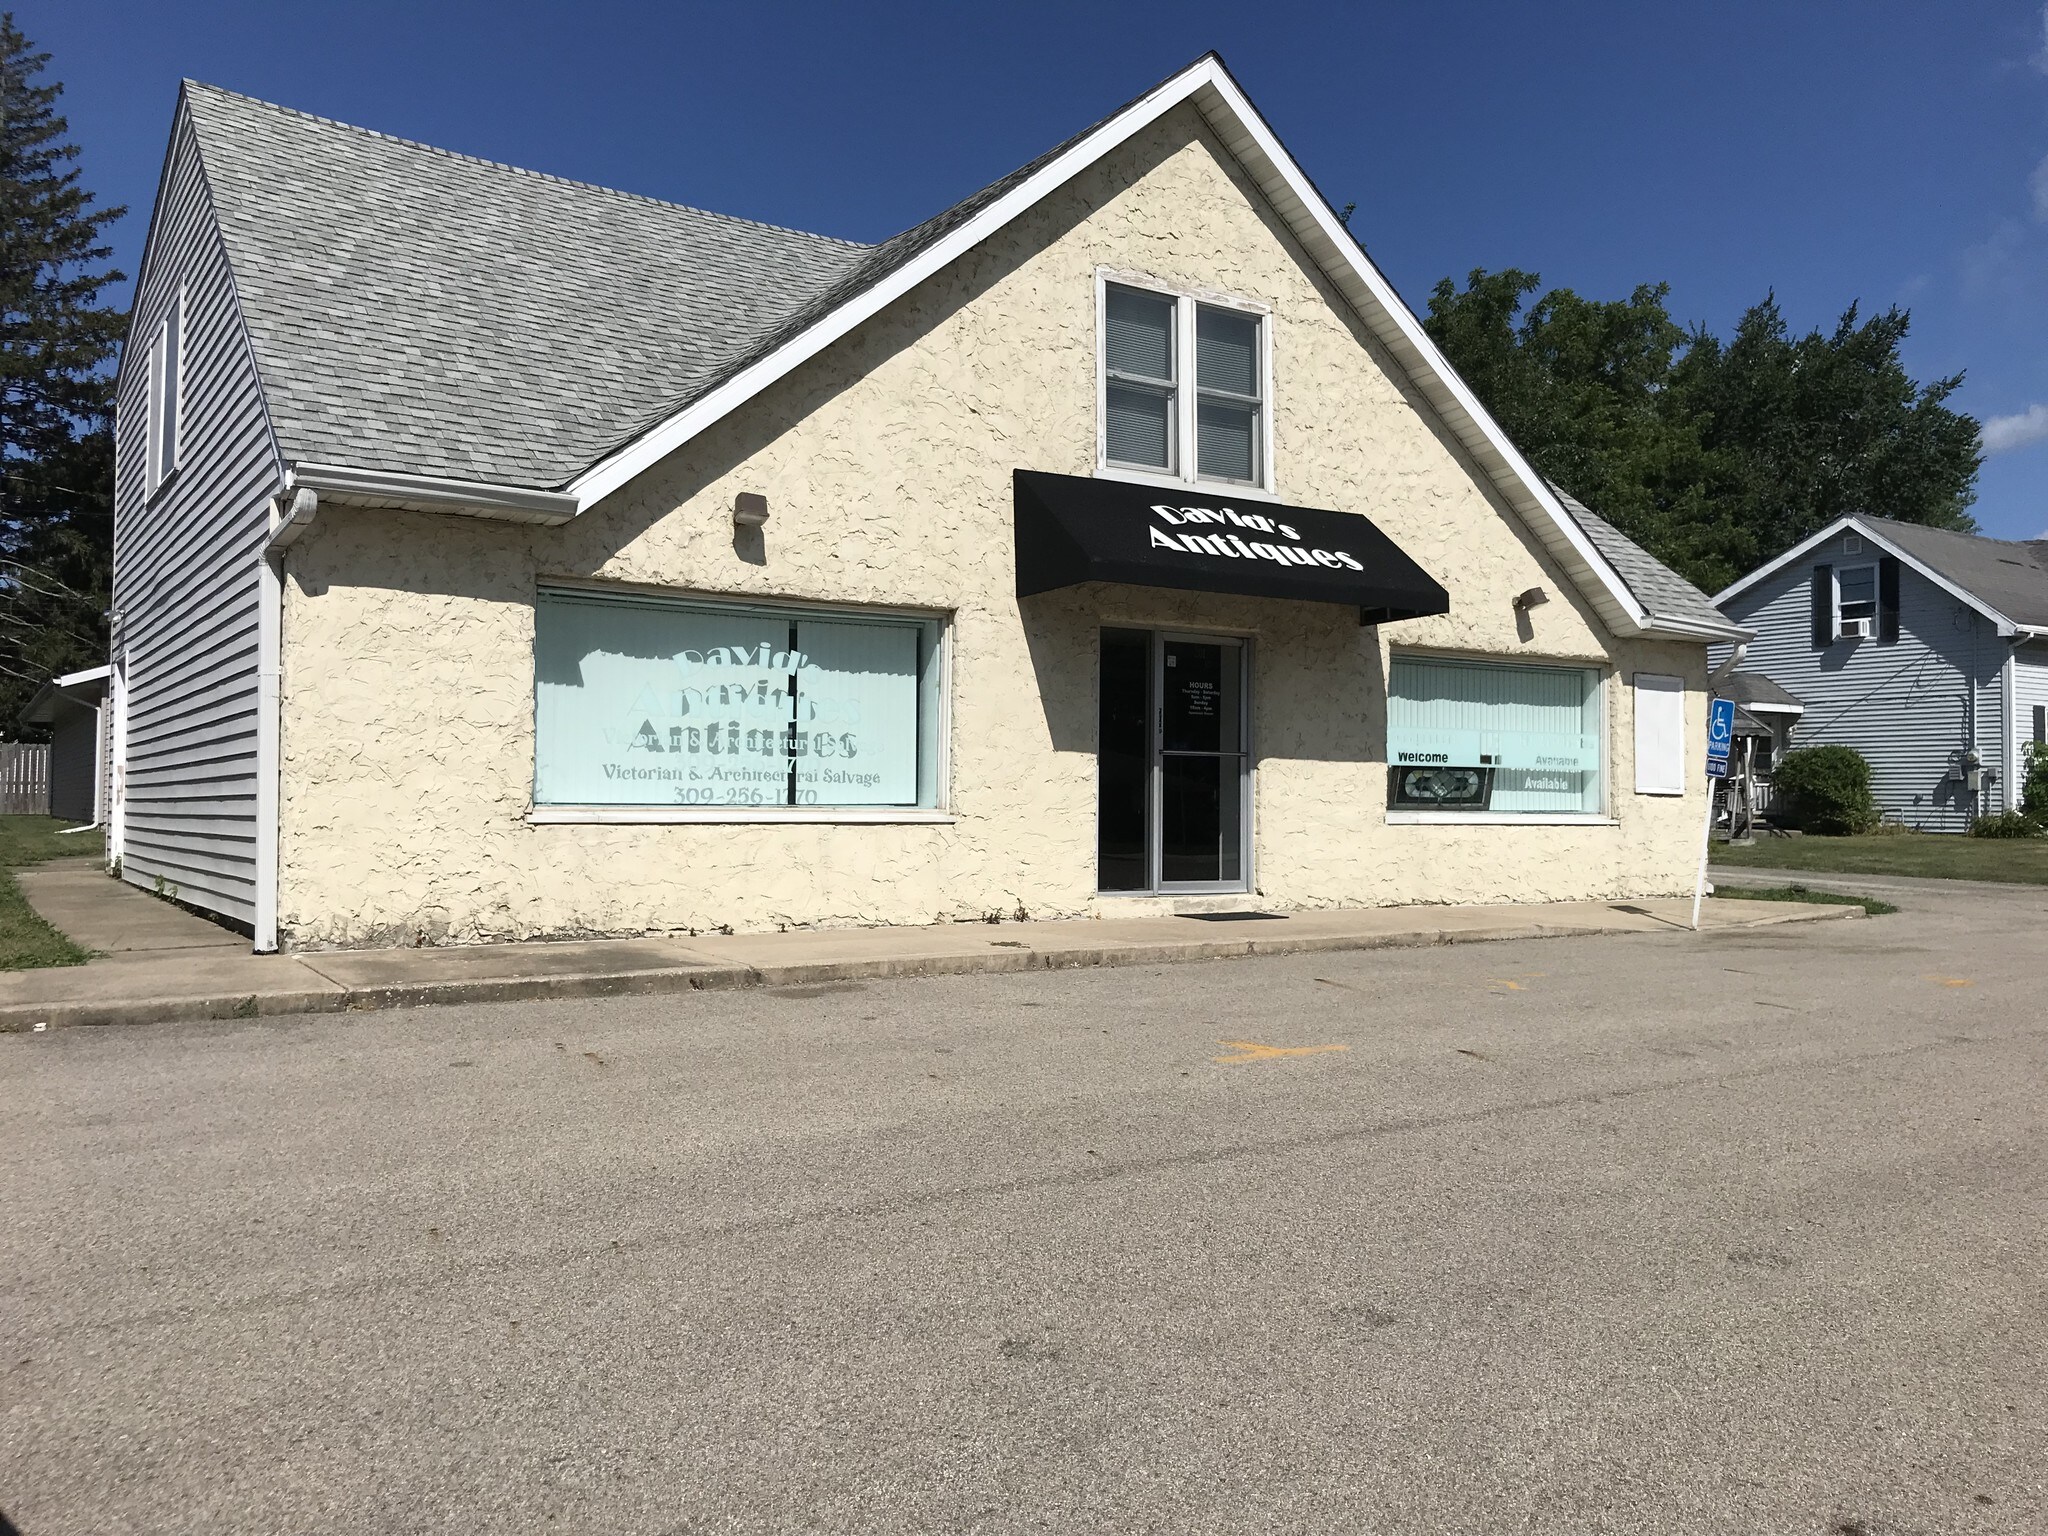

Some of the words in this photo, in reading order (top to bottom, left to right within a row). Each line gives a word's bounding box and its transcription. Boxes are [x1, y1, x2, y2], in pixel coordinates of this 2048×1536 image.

[1149, 503, 1301, 541] David's
[1148, 525, 1365, 573] Antiques
[672, 641, 823, 685] David's
[1189, 681, 1213, 690] HOURS
[1709, 741, 1730, 752] PARKING
[1398, 751, 1449, 763] Welcome
[602, 763, 683, 781] Victorian
[822, 768, 881, 788] Salvage
[1524, 776, 1569, 790] Available
